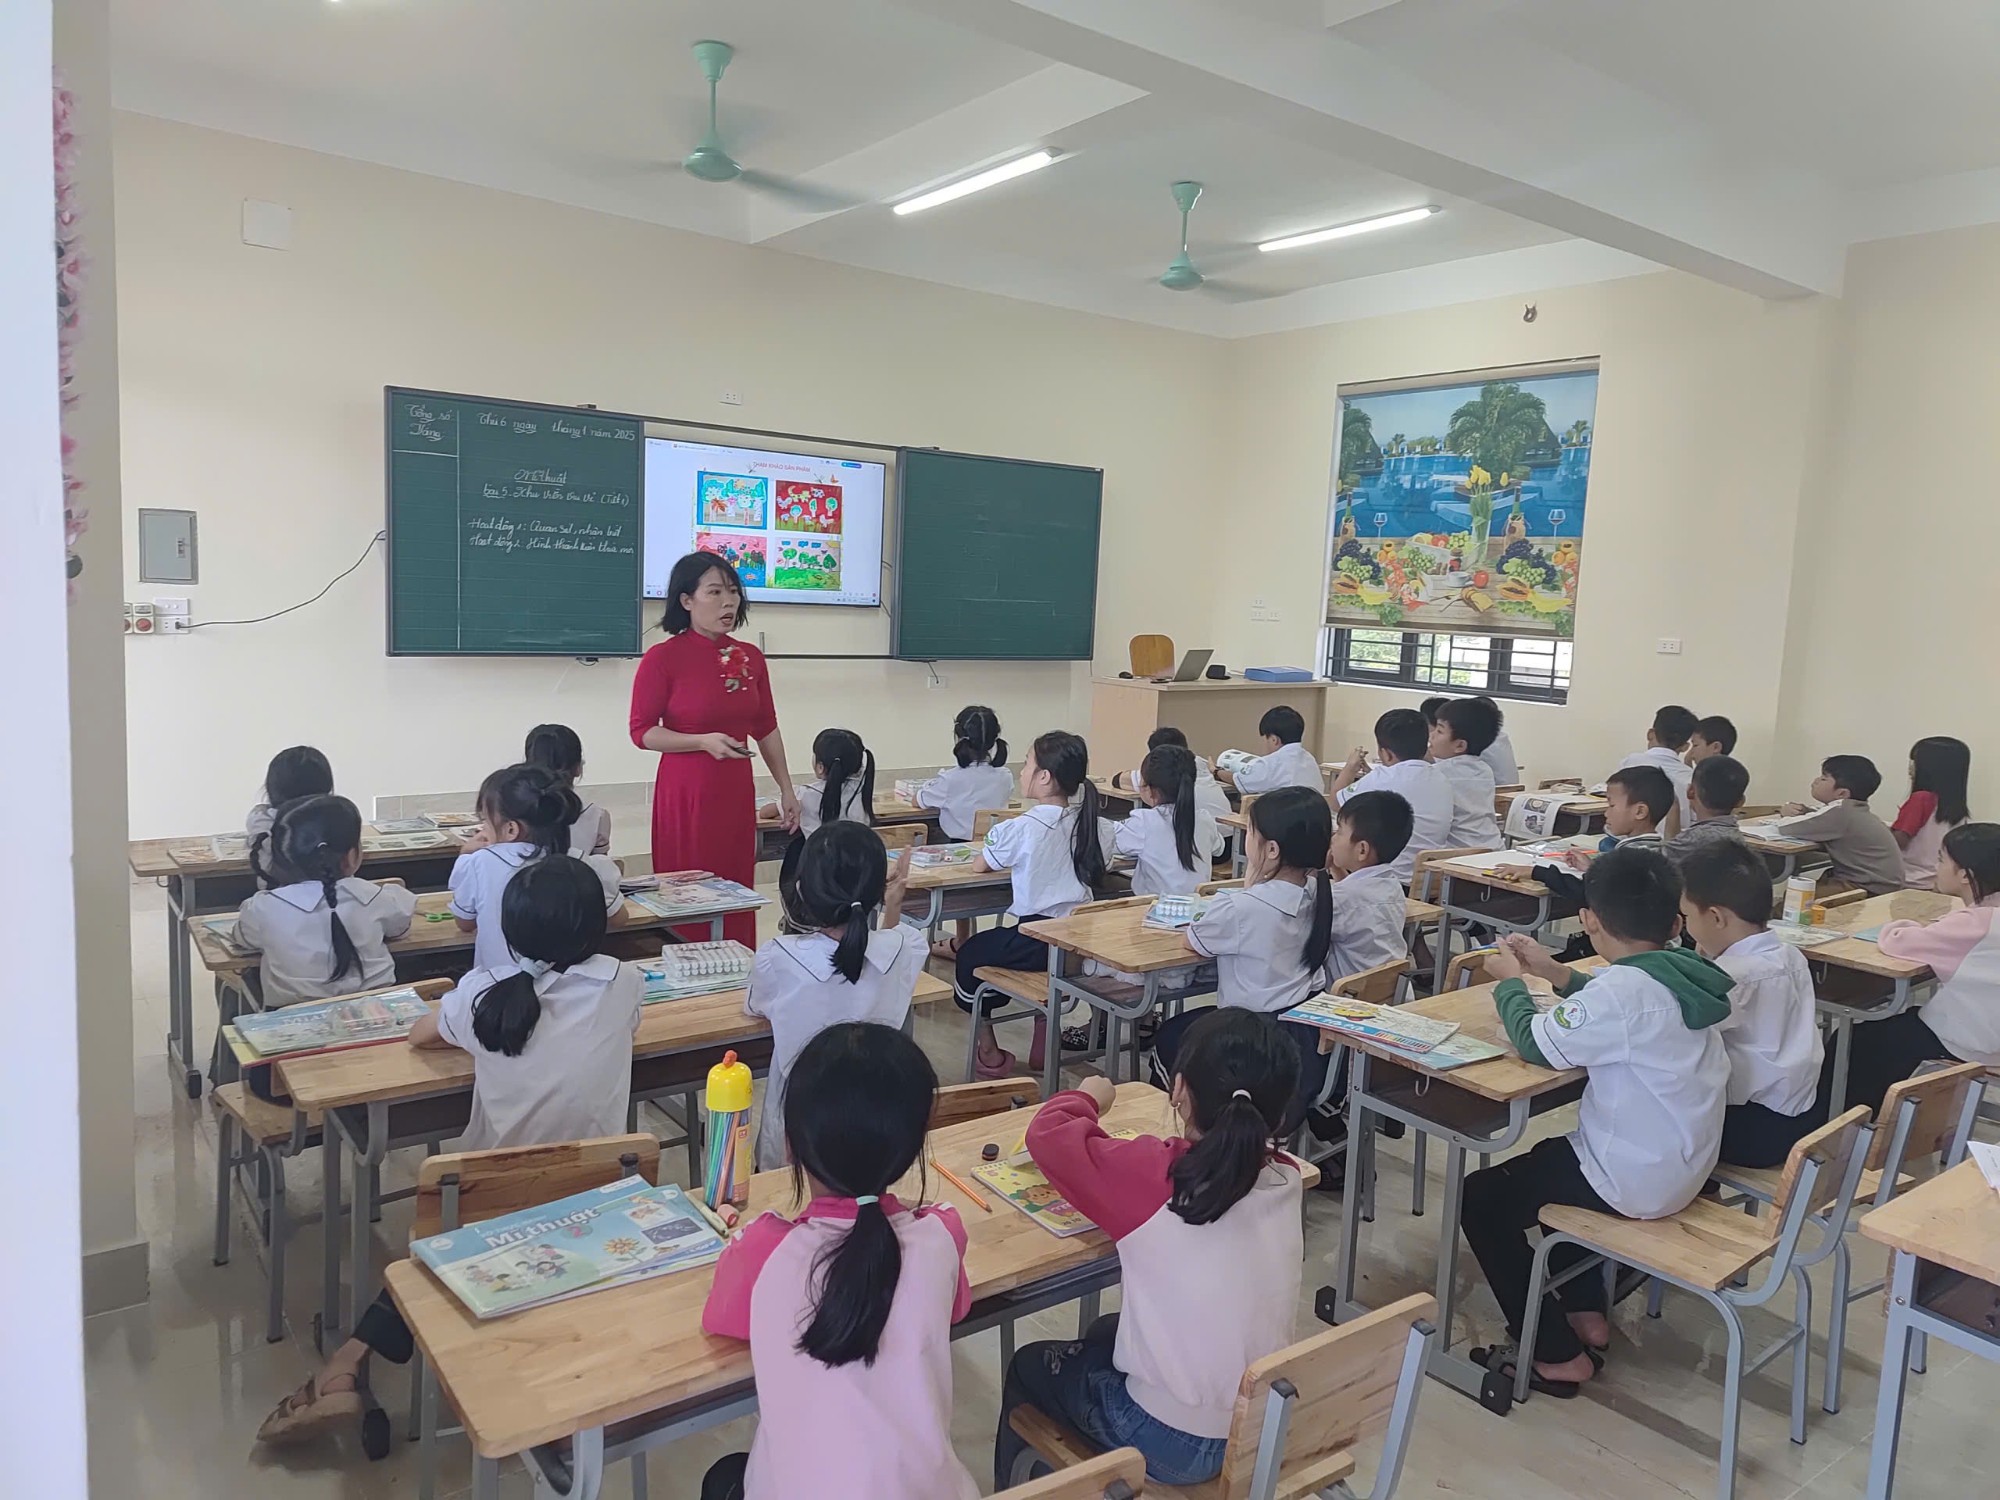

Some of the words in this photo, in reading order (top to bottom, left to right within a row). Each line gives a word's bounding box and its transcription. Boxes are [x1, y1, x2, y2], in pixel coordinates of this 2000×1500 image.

[500, 416, 507, 427] 6
[614, 428, 636, 441] 2025
[485, 1226, 525, 1249] Mĩ
[525, 1206, 602, 1236] thuật
